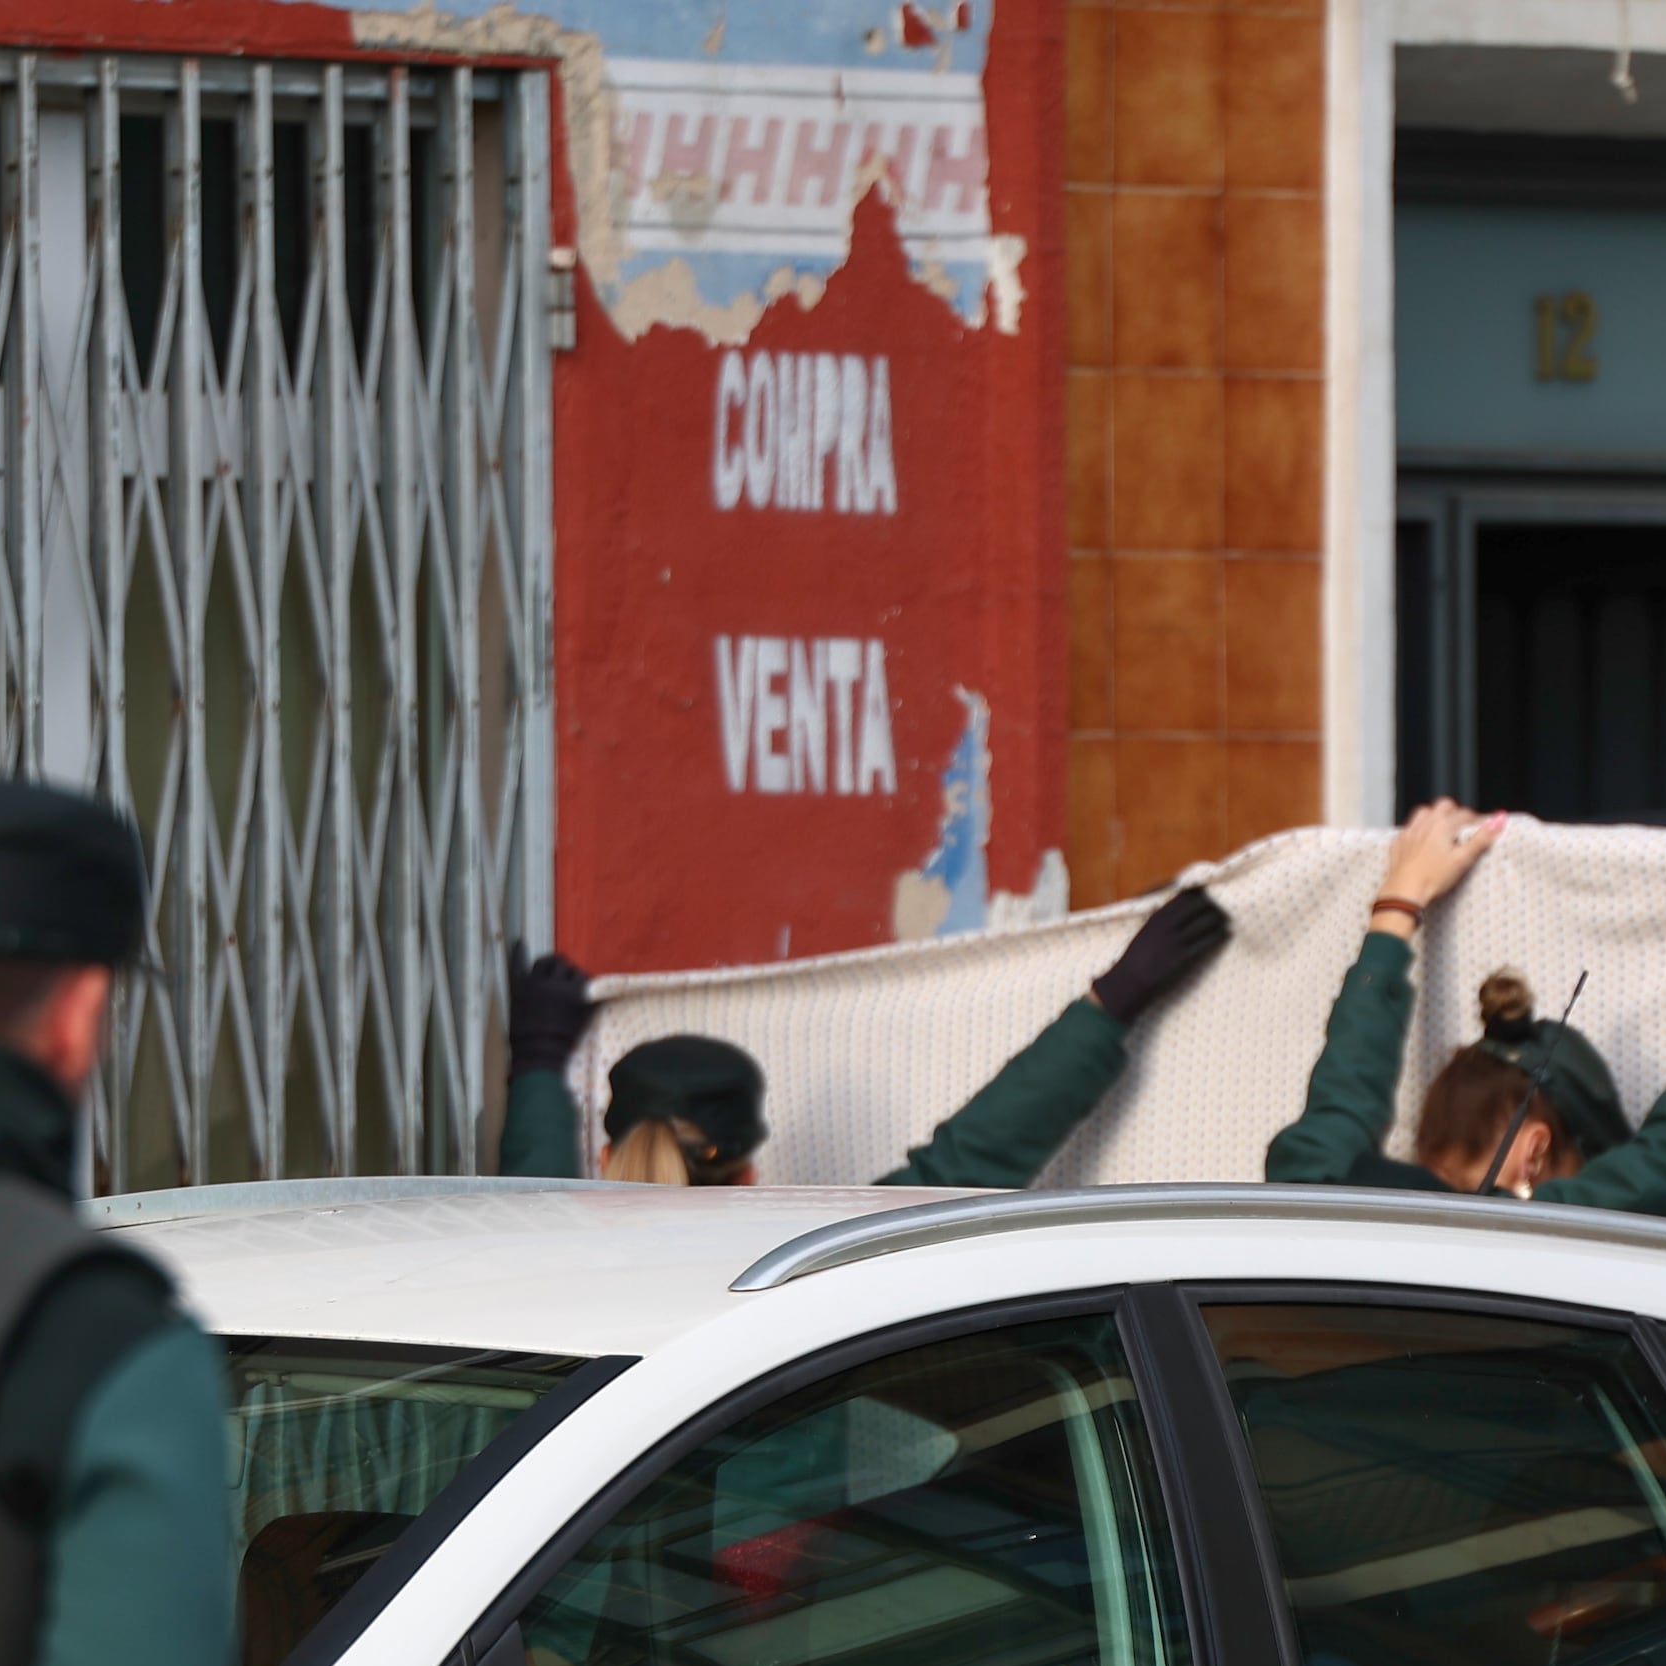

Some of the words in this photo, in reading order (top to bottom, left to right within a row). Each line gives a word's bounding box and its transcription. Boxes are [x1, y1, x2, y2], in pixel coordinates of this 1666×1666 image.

[1533, 290, 1600, 384] 12
[713, 349, 898, 516] COMPRA
[714, 634, 898, 796] VENTA
